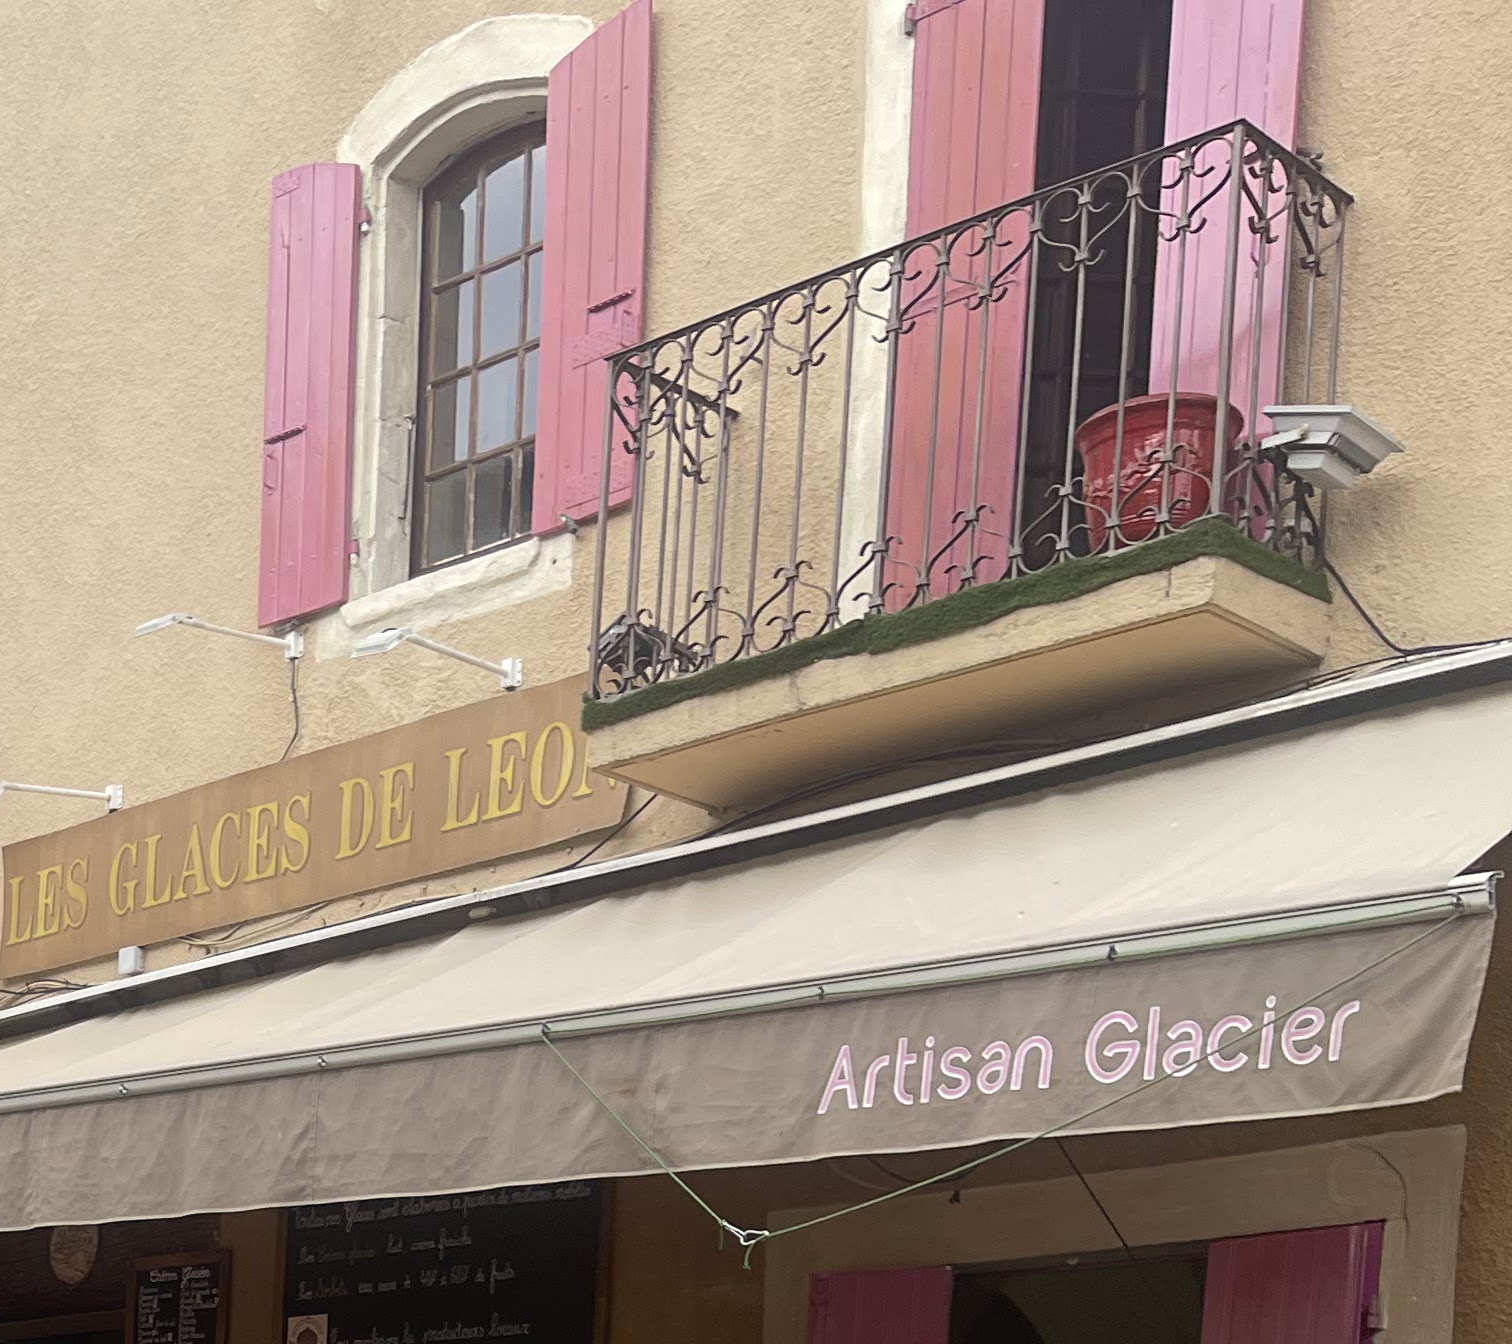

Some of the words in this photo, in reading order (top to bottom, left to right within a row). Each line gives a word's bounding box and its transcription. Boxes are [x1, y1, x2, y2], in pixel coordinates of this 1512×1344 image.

[5, 856, 89, 947] LES
[108, 791, 312, 917] GLACES
[335, 761, 416, 860] DE
[818, 1036, 1054, 1115] Artisan
[1085, 995, 1361, 1083] Glacier
